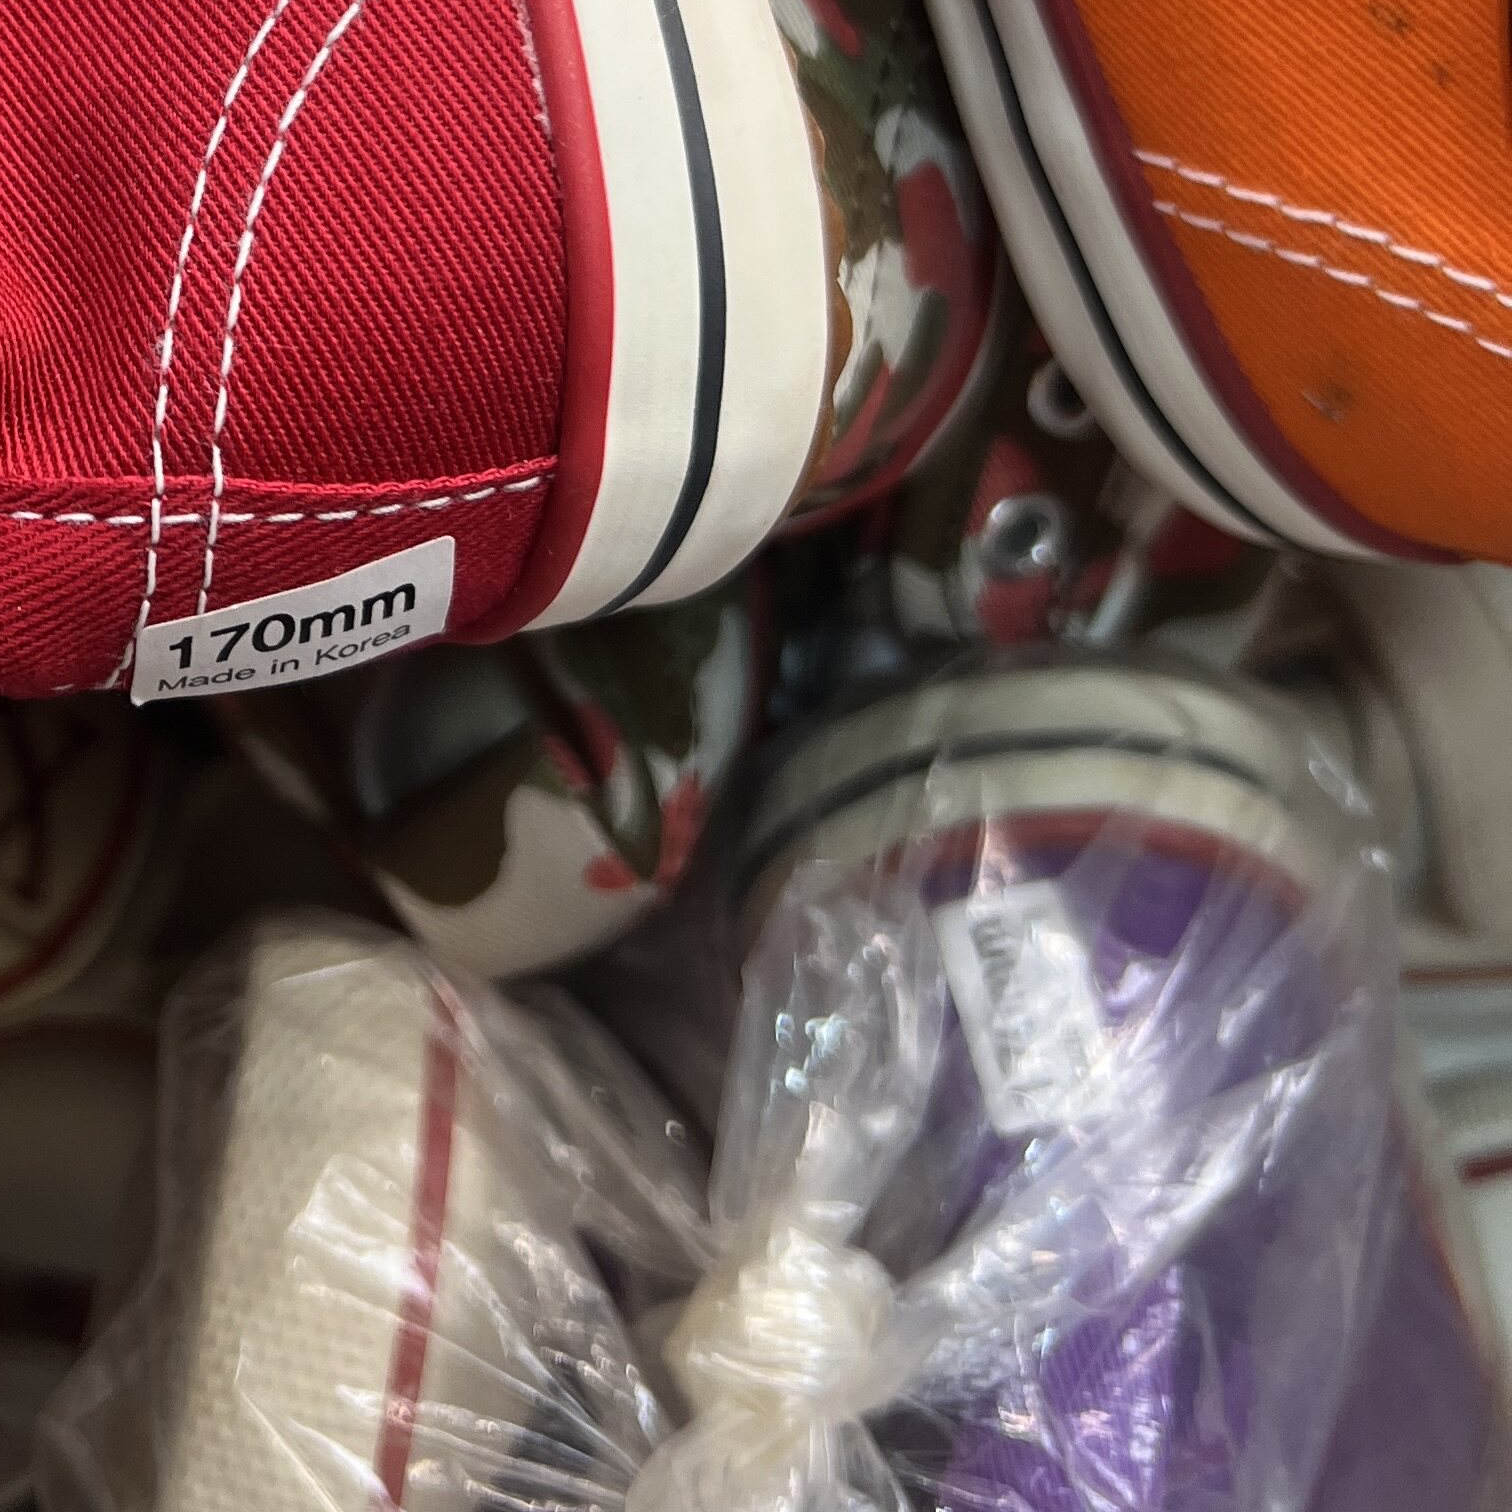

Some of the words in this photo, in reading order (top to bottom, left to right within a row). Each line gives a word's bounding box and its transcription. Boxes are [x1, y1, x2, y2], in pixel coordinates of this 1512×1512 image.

[157, 666, 256, 692] Made
[270, 658, 300, 676] in
[314, 623, 412, 666] Korea
[168, 582, 417, 670] 170mm
